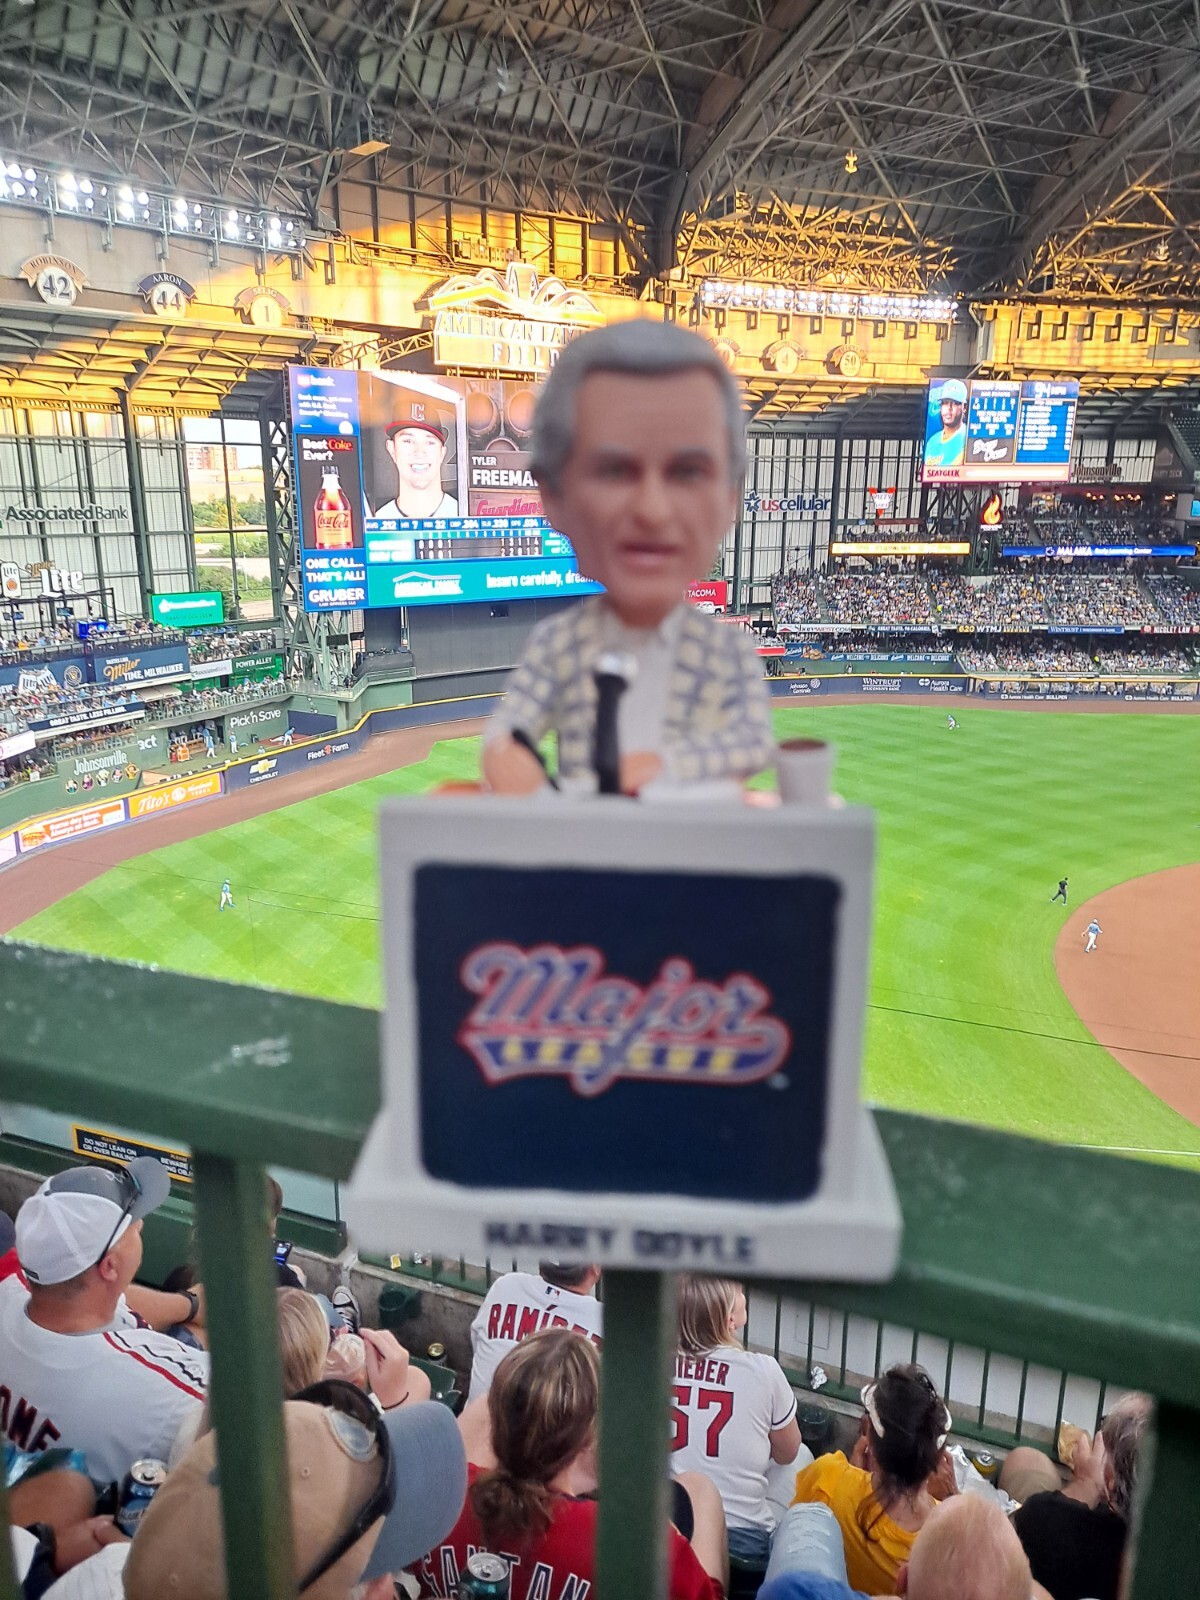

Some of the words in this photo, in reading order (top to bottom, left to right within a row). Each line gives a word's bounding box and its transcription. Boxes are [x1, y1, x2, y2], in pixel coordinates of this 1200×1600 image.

[43, 274, 72, 298] 42
[152, 273, 182, 286] AARON
[156, 291, 182, 311] 44
[439, 314, 534, 342] AMERICAN
[843, 354, 858, 367] 50
[302, 438, 328, 449] Best
[328, 438, 352, 450] Coke
[303, 451, 334, 461] Ever?
[472, 456, 497, 466] TYLER
[472, 468, 539, 487] FREEMA
[927, 469, 960, 478] SEATGEEK
[1071, 463, 1122, 478] Johnsonville
[6, 500, 93, 520] Associated
[95, 500, 128, 519] Bank
[305, 558, 330, 569] ONE
[39, 568, 83, 599] Lite
[305, 571, 343, 582] THAT'S
[520, 570, 564, 587] carefully,
[308, 587, 365, 602] GRUBER
[688, 589, 717, 598] TACOMA
[958, 625, 976, 633] 620
[1154, 626, 1177, 634] NICOLET
[235, 660, 256, 668] POWER
[256, 656, 273, 665] ALLEY
[103, 659, 141, 682] Miller
[144, 663, 184, 678] MILWAUKEE
[49, 717, 70, 727] GREAT
[89, 710, 104, 719] LESS
[258, 708, 281, 722] Save
[307, 749, 326, 760] Fleet
[332, 743, 350, 754] Farm
[73, 750, 128, 776] Johnsonville
[249, 771, 279, 784] CHEVROLET
[138, 792, 171, 813] Tito's
[457, 942, 792, 1096] Major
[82, 1143, 93, 1151] OR
[92, 1146, 111, 1156] OVER
[84, 1137, 95, 1146] DO
[94, 1141, 108, 1150] NOT
[108, 1144, 126, 1154] LEAN
[126, 1148, 138, 1157] ON
[160, 1157, 189, 1170] BEWARE
[483, 1220, 619, 1254] HARRY
[631, 1226, 757, 1266] DOYLE
[487, 1303, 602, 1345] RAMÍ
[674, 1355, 730, 1386] IEBER
